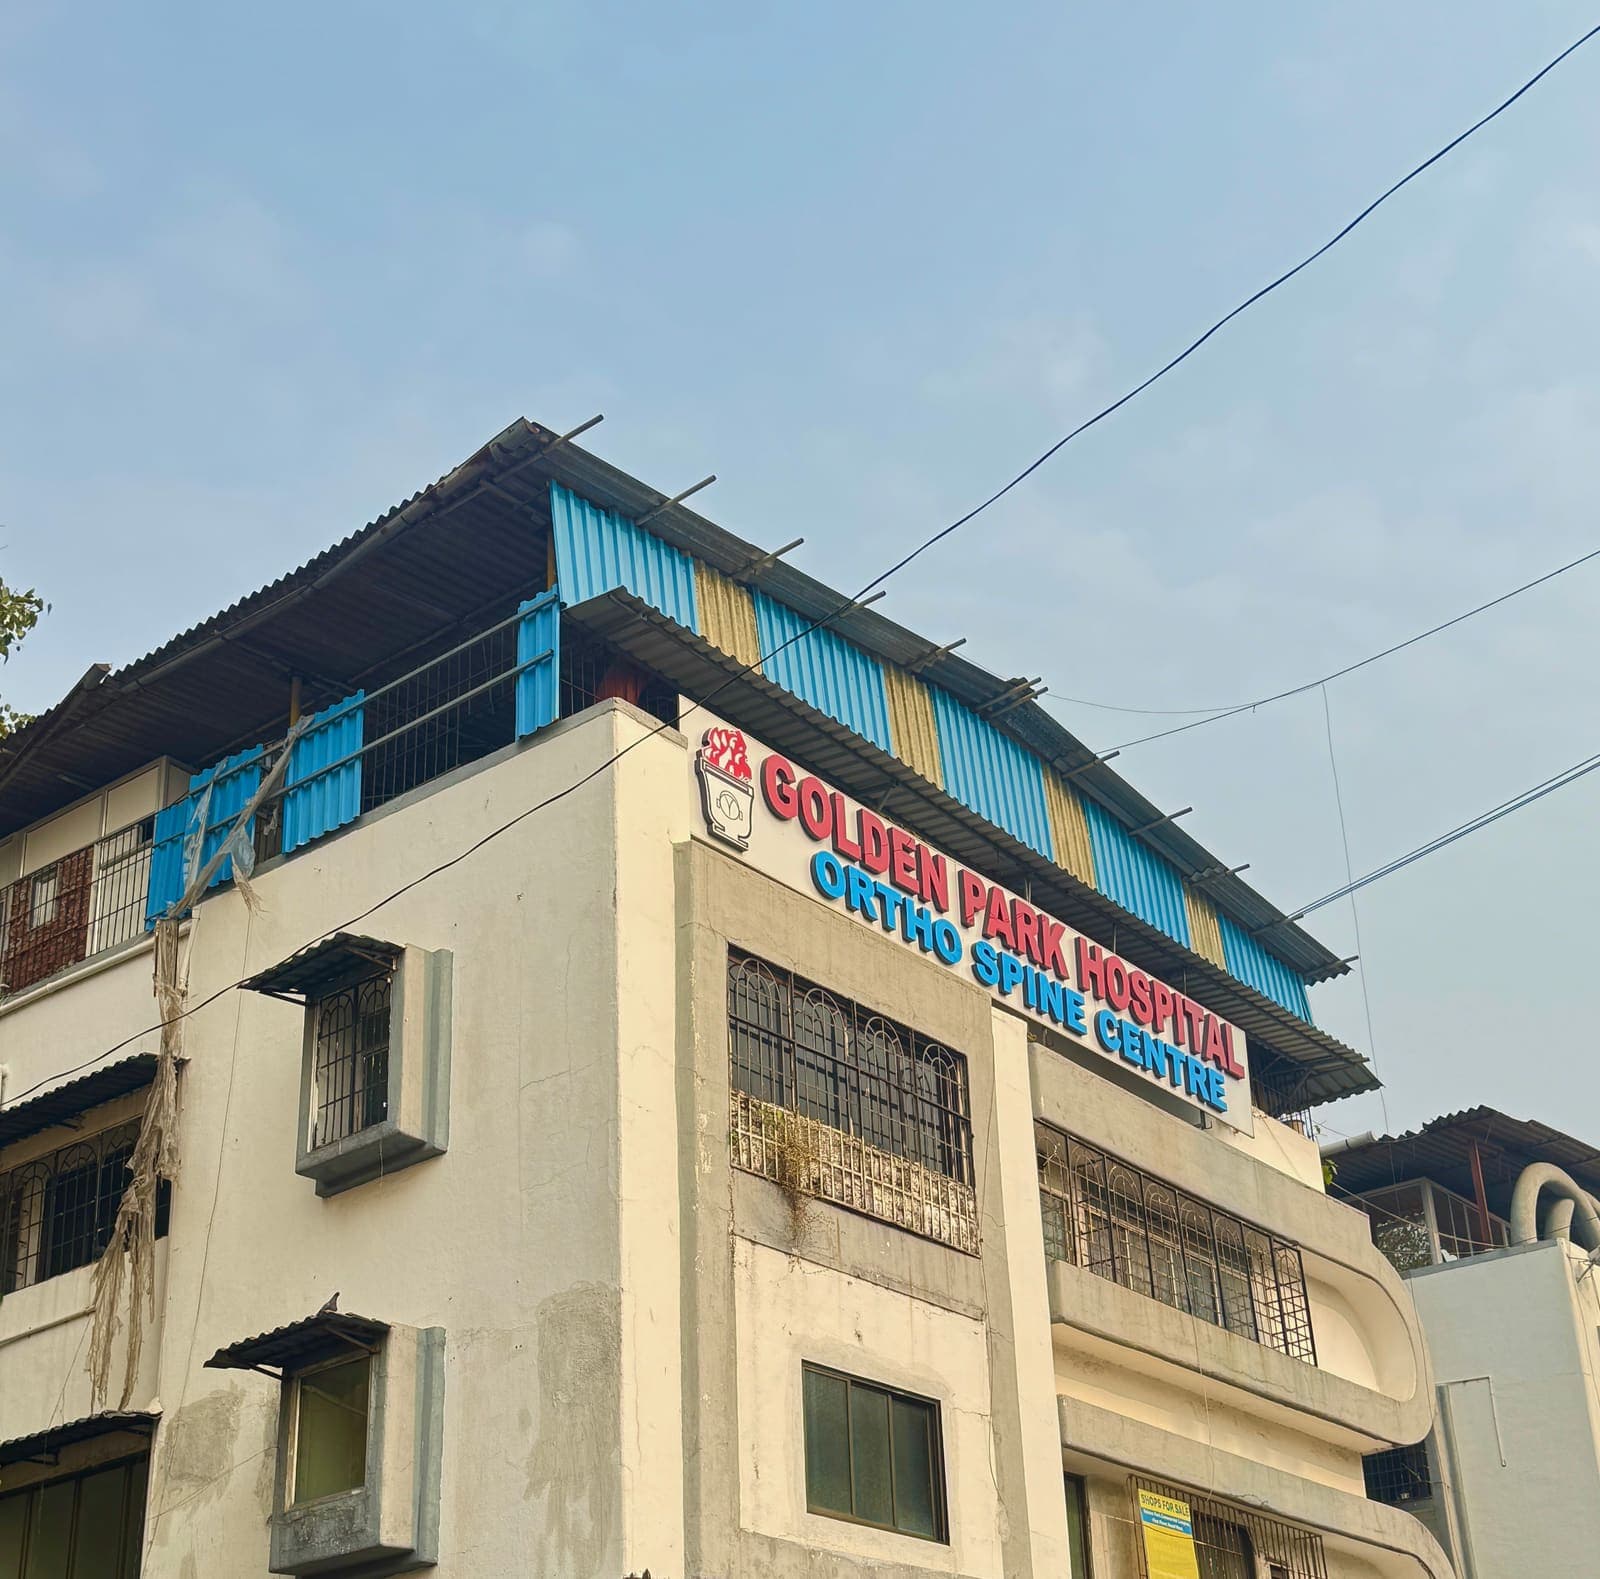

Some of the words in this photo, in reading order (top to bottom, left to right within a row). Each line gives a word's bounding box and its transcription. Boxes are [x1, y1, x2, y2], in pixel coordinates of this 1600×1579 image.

[760, 754, 949, 913] GOLDEN
[958, 869, 1070, 980] PARK
[1074, 936, 1245, 1080] HOSPITAL
[810, 851, 963, 965] ORTHO
[971, 940, 1088, 1036] SPINE
[1094, 1009, 1228, 1113] CENTRE
[1140, 1493, 1162, 1508] SHOPS
[1162, 1500, 1175, 1512] FOR
[1175, 1503, 1190, 1517] SALE
